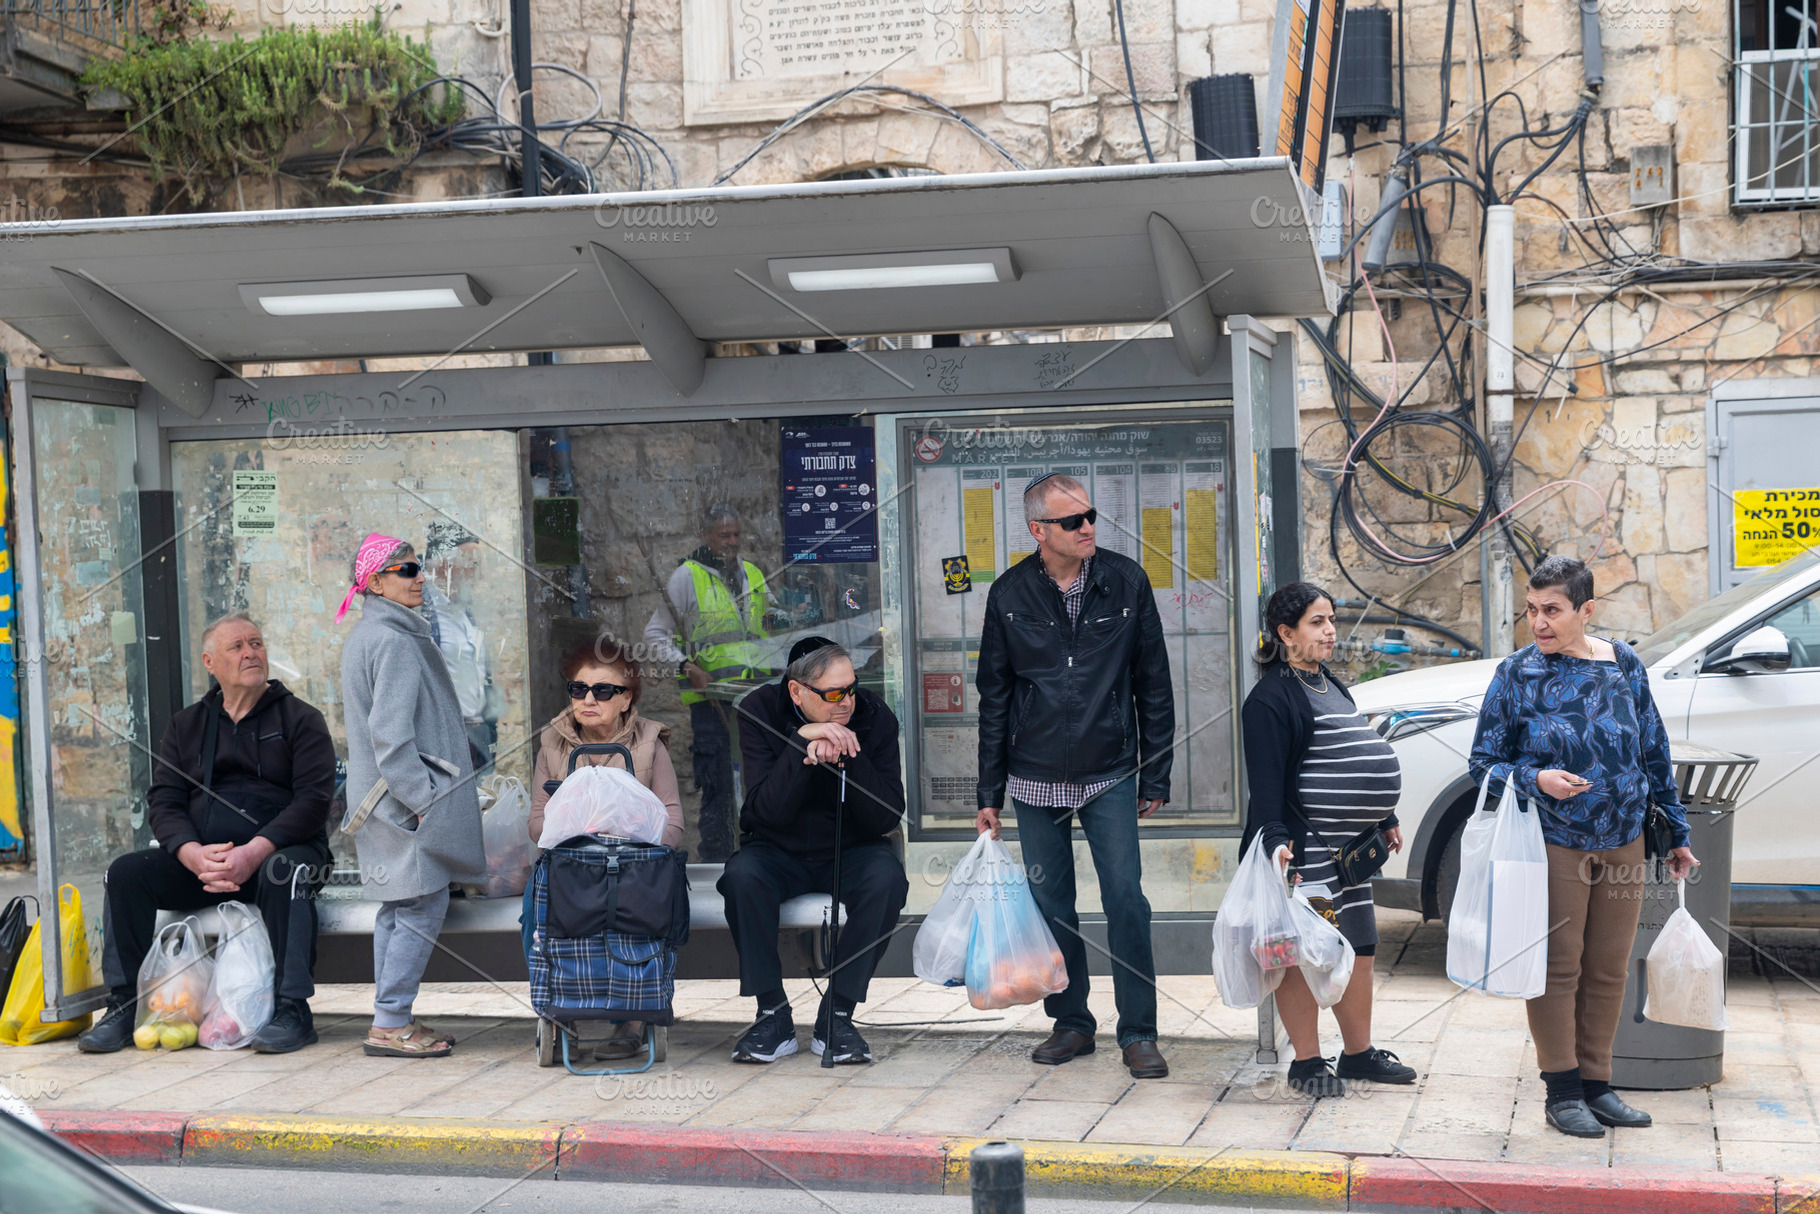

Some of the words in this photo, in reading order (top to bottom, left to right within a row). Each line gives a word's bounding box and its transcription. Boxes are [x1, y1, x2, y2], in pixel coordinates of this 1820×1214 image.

[1100, 432, 1128, 442] מחנה
[1130, 431, 1150, 442] שוק
[1195, 436, 1222, 445] 03523
[801, 456, 837, 471] תחבורתי
[839, 455, 857, 471] צדק
[1209, 463, 1220, 472] 18
[980, 470, 998, 479] 202
[1070, 466, 1087, 475] 105
[1115, 465, 1131, 474] 104
[1764, 490, 1820, 502] מכירת
[248, 505, 266, 514] 6.29
[1744, 507, 1788, 520] מלאי
[1743, 530, 1778, 540] הנחה
